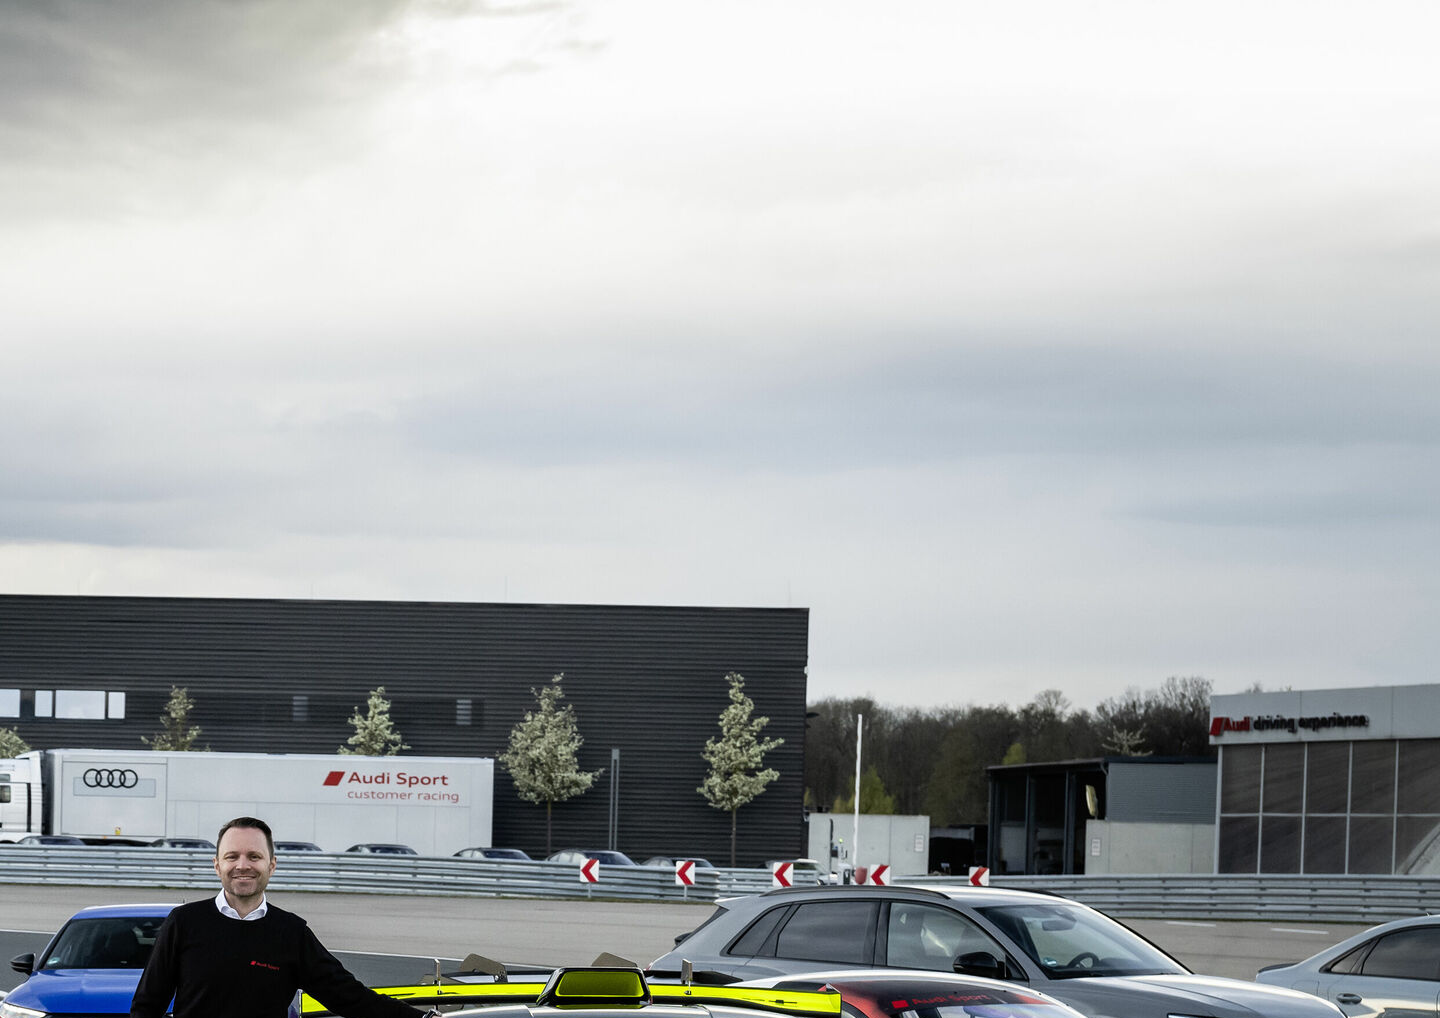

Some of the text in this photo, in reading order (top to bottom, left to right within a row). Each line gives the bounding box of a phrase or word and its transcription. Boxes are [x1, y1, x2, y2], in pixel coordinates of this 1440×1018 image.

[1223, 711, 1368, 733] Audi driving experience
[348, 771, 449, 788] Audi Sport
[347, 789, 460, 804] customer racing
[912, 994, 991, 1005] Audi Sport
